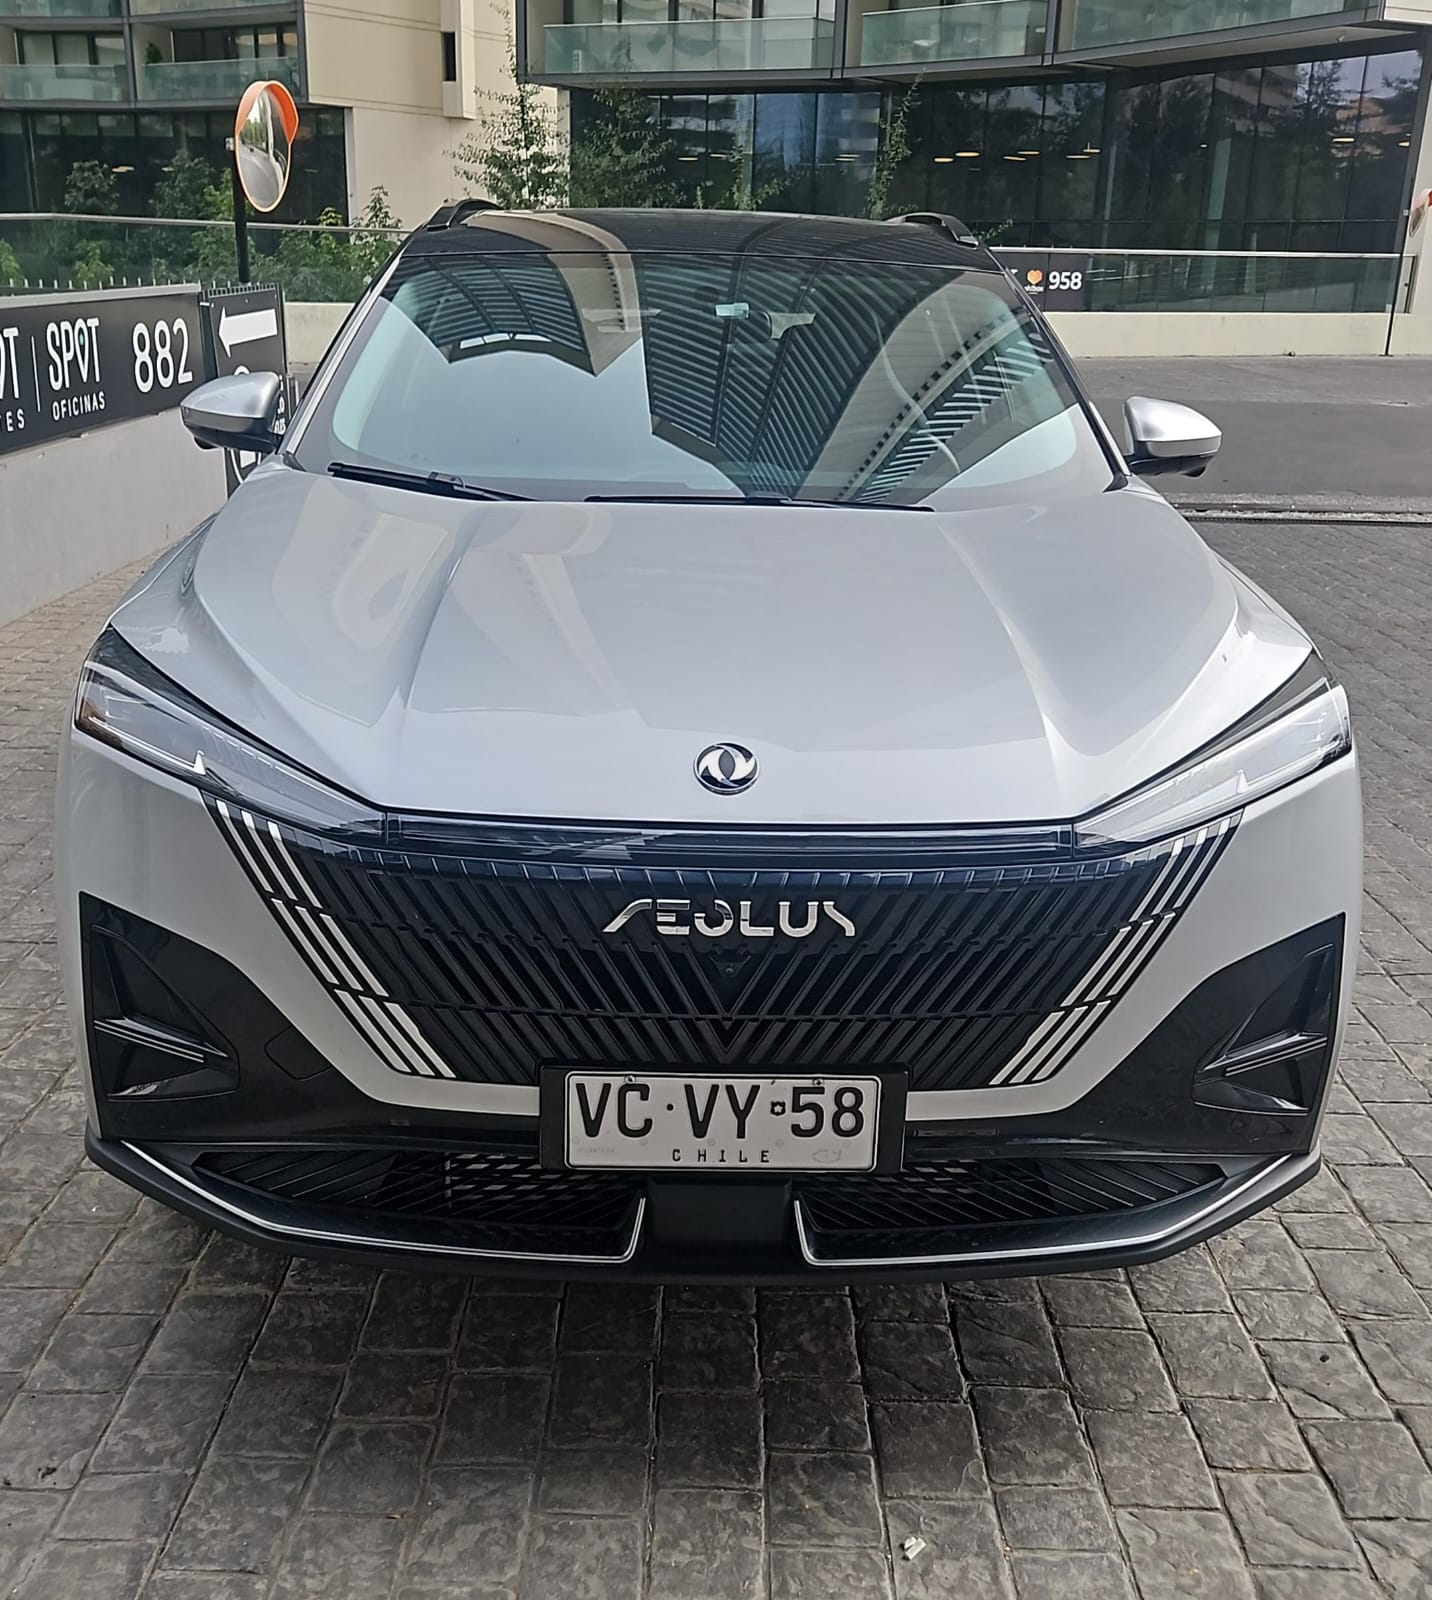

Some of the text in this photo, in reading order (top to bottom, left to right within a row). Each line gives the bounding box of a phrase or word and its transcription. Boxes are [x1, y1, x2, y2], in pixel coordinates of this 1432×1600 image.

[1048, 271, 1082, 290] 958
[46, 317, 100, 391] SPOT
[132, 318, 193, 392] 882
[52, 391, 106, 421] OFICINAS
[671, 1149, 770, 1163] CHILE
